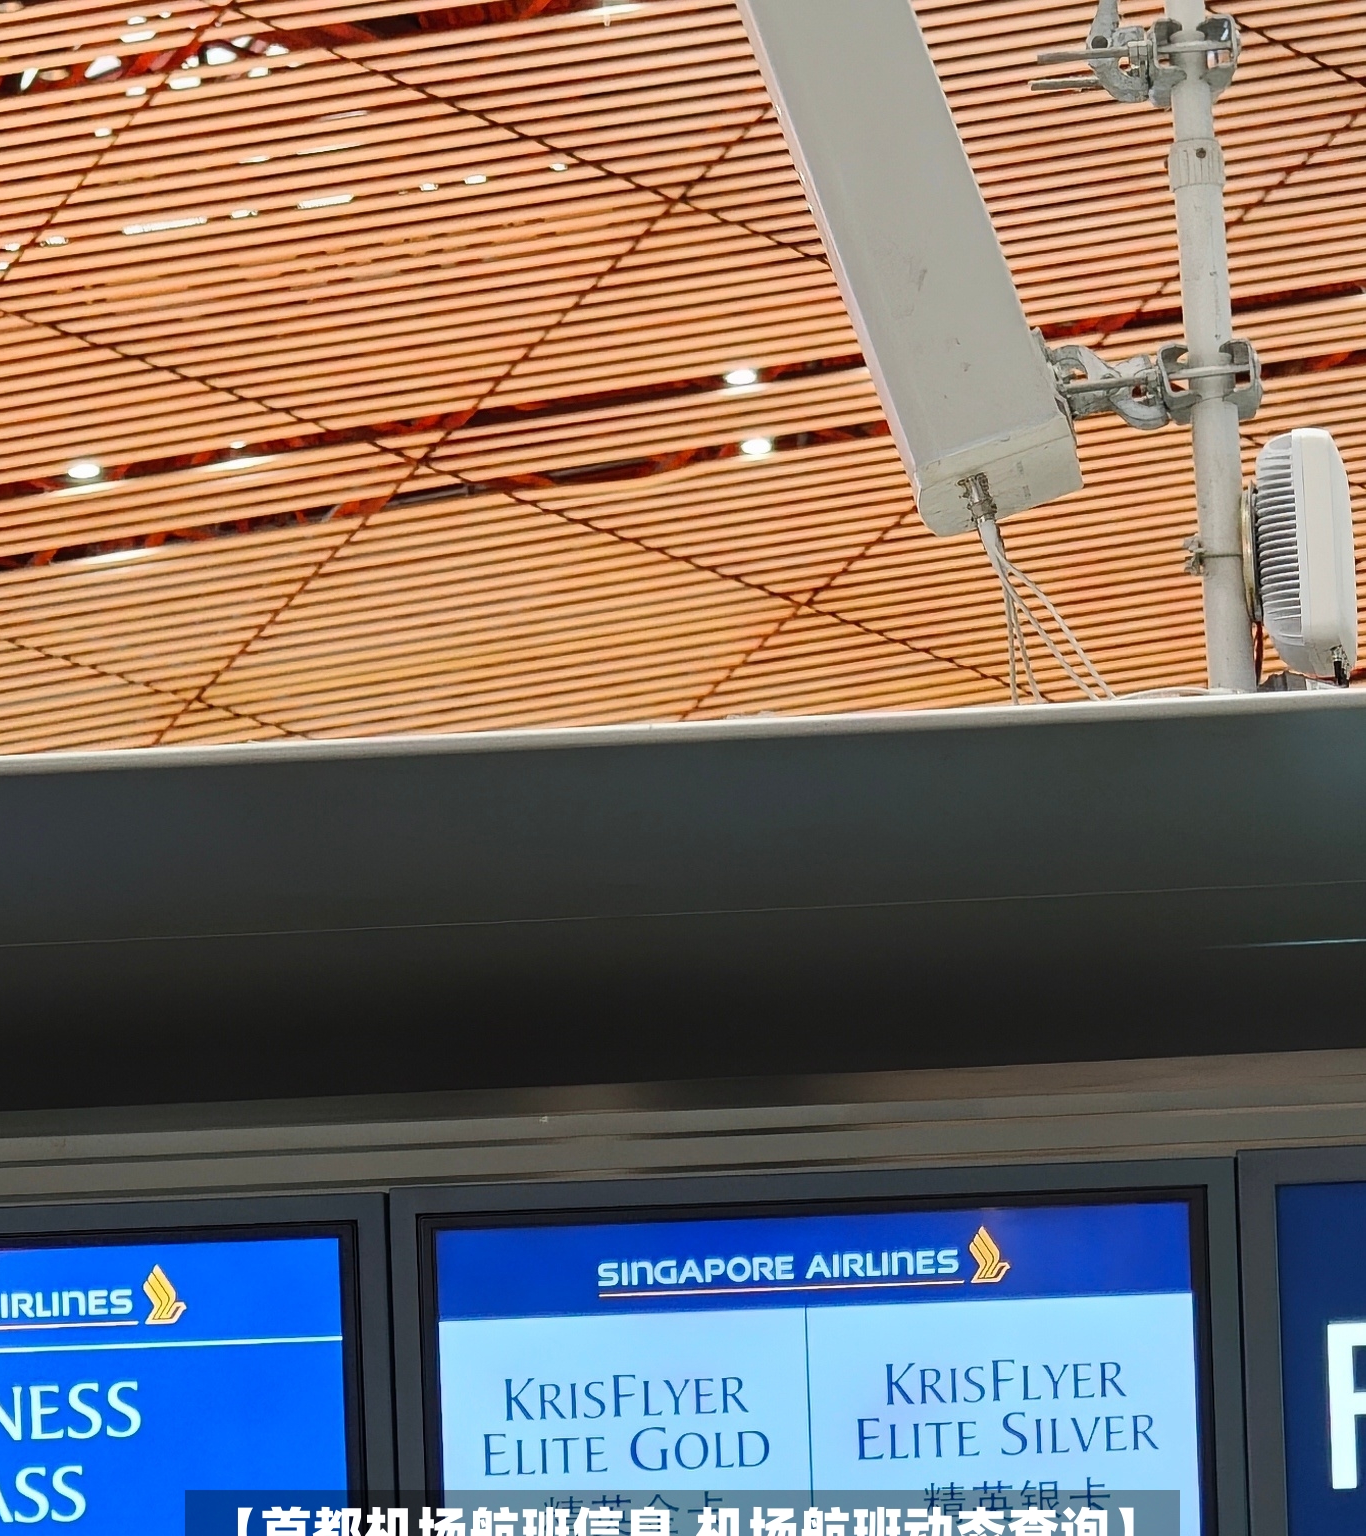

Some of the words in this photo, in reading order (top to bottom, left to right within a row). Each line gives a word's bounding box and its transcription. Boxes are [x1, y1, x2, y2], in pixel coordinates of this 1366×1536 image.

[598, 1256, 794, 1286] SINGAPORE
[806, 1249, 959, 1279] AIRLINES
[484, 1434, 607, 1476] ELITE
[630, 1427, 769, 1471] GOLD
[858, 1418, 979, 1460] ELITE
[1001, 1412, 1158, 1455] SILVER
